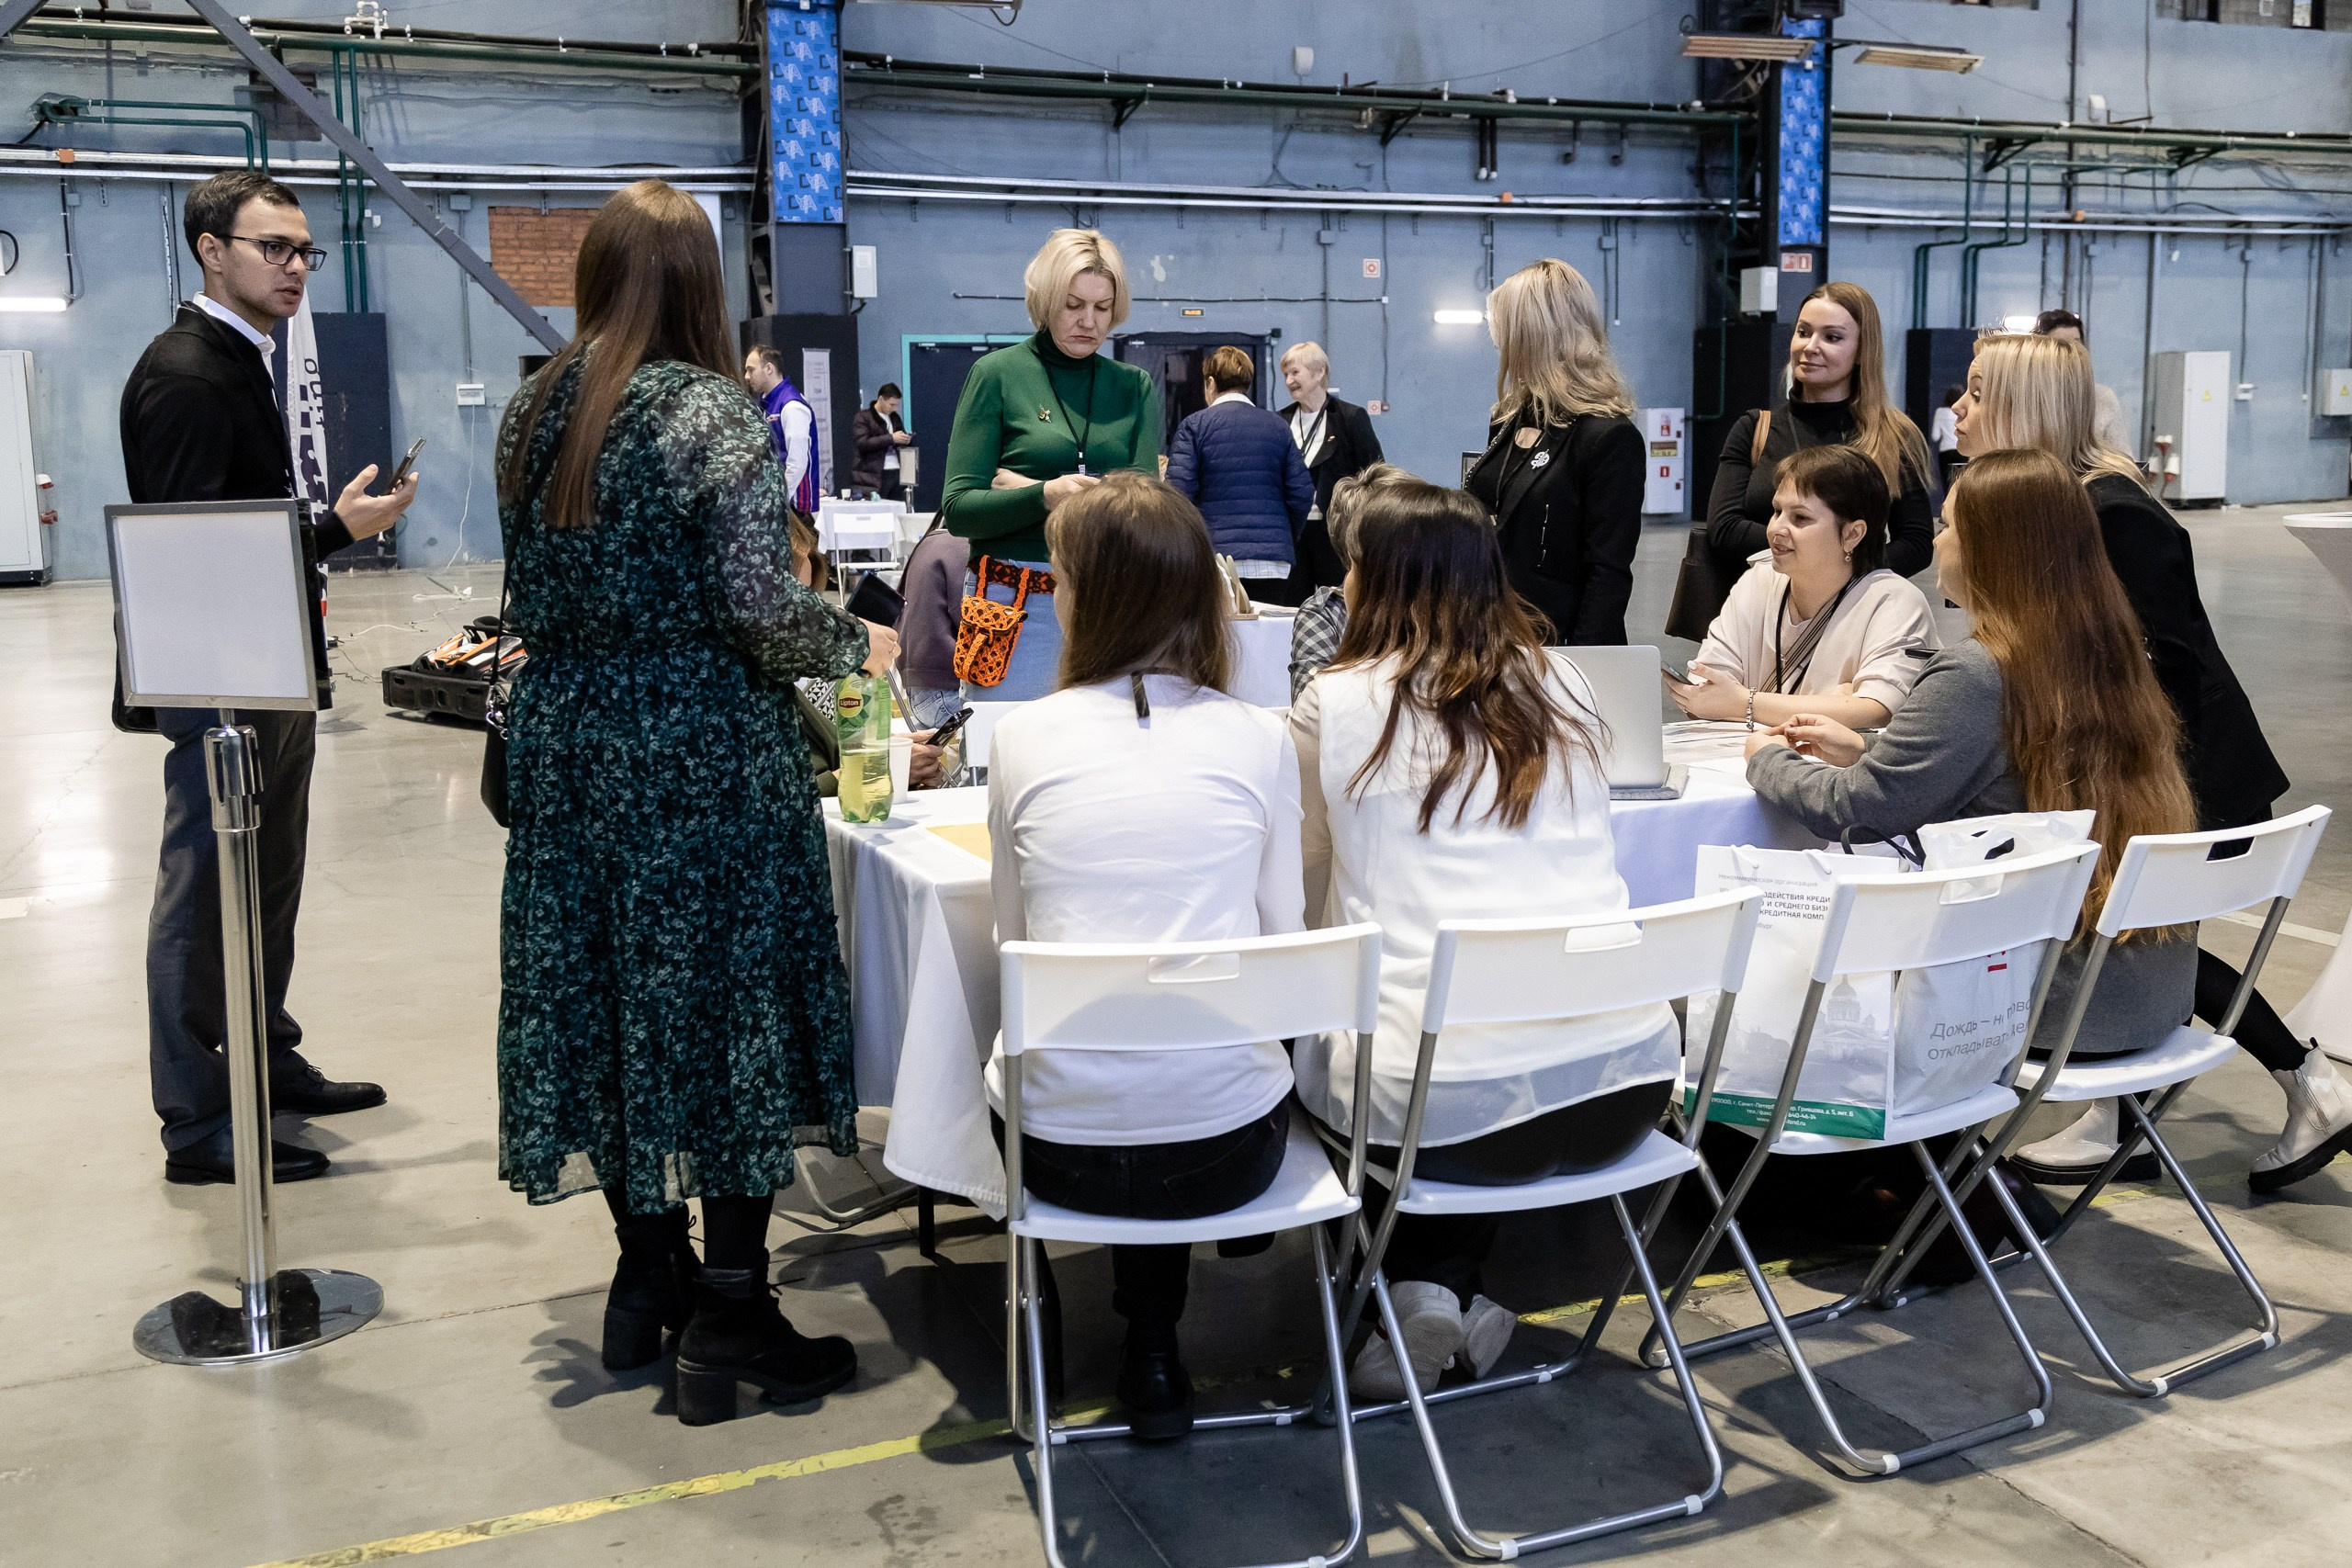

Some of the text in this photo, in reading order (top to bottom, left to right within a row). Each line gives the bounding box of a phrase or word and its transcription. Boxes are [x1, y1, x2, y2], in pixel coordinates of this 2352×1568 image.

[1718, 874, 1818, 887] Некоммерческая организация
[1774, 901, 1810, 910] СРЕДНЕГО
[1929, 1020, 1978, 1041] Дождь
